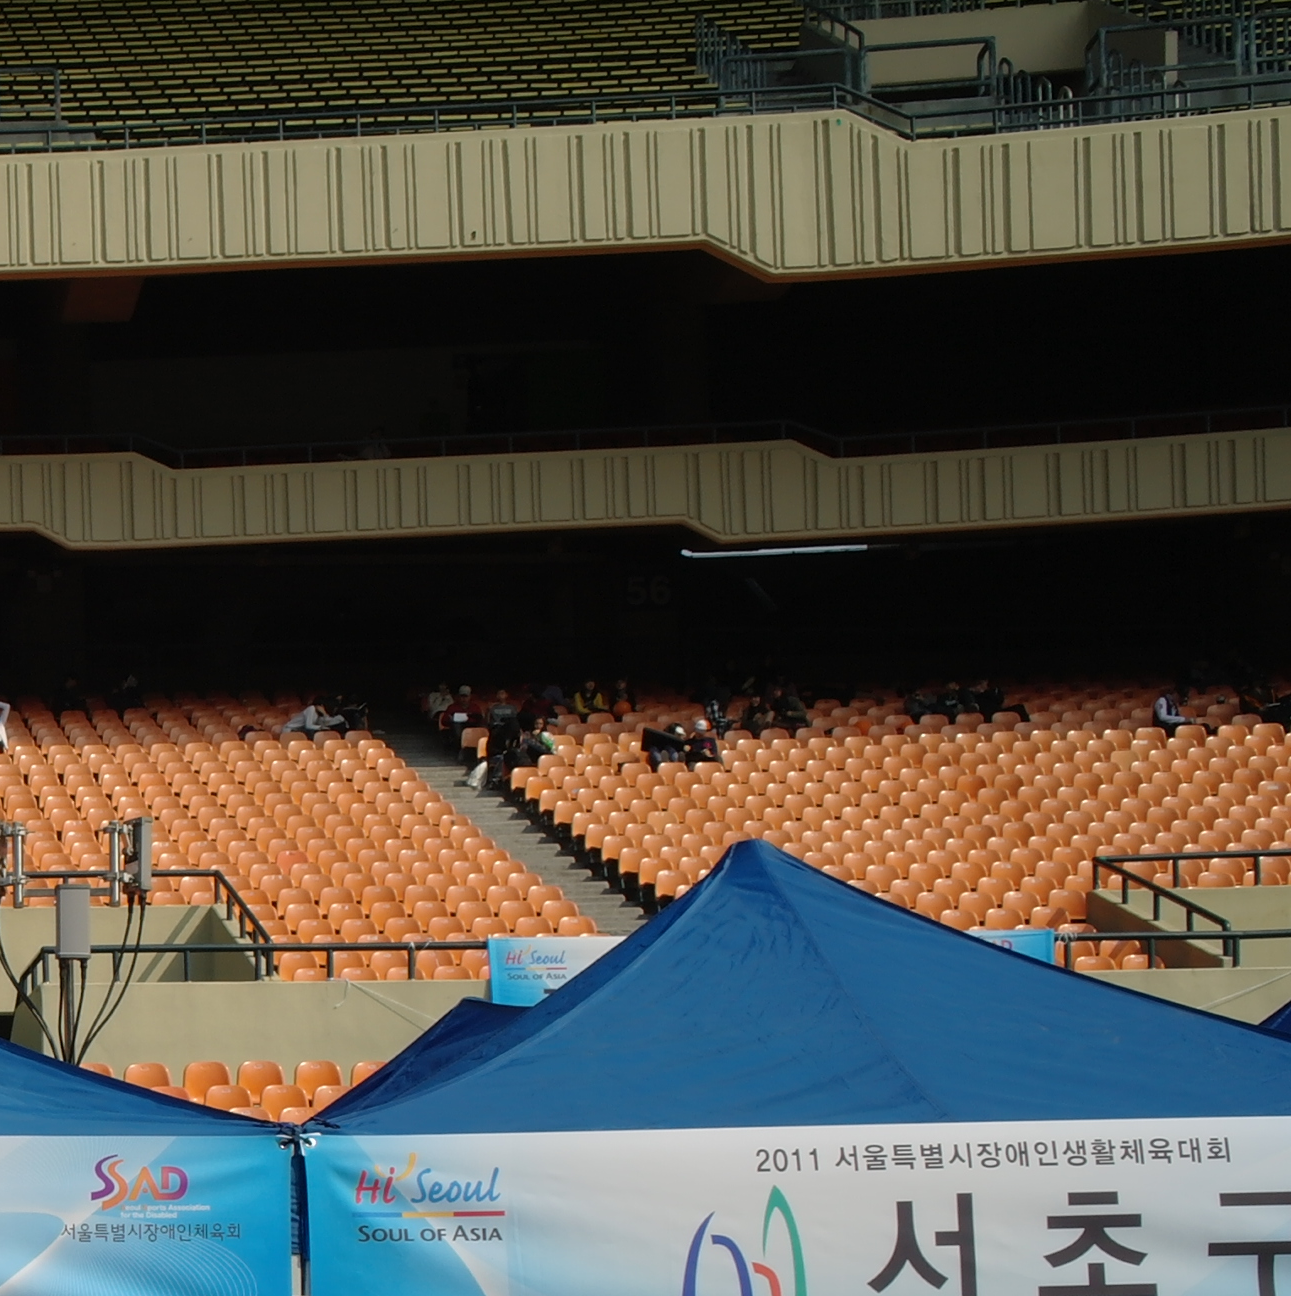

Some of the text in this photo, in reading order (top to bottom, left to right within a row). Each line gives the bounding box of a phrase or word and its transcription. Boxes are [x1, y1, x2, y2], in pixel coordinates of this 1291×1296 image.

[625, 574, 672, 606] 56
[505, 950, 565, 965] Hi Seoul
[546, 972, 567, 980] ASIA
[756, 1136, 1232, 1172] 2011 서울특별시장애인생활체육대회
[91, 1154, 188, 1210] SSAD
[355, 1166, 501, 1204] Hi Seoul
[61, 1222, 240, 1242] 서울특별시장애인체육회
[358, 1225, 503, 1242] SOUL OF ASIA
